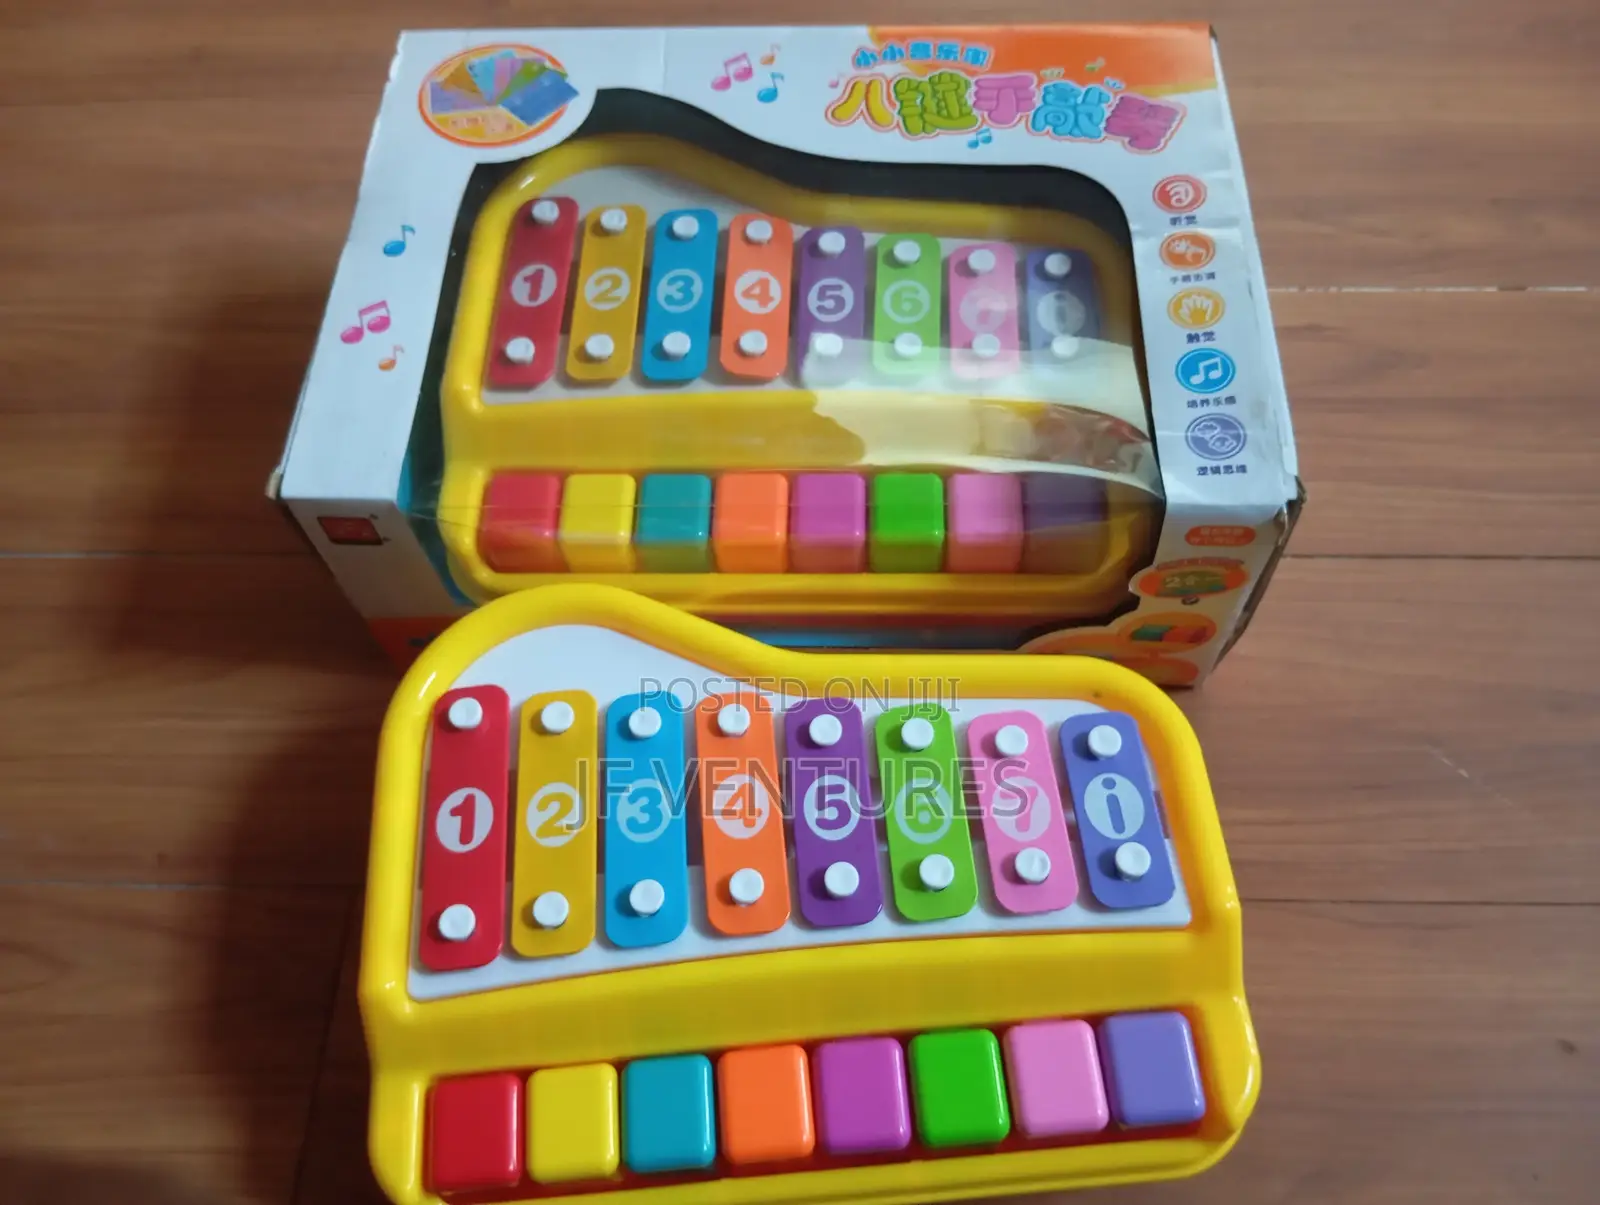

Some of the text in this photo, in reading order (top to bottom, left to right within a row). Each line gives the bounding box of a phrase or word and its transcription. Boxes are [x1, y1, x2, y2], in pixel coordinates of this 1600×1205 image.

[523, 269, 545, 301] 1
[591, 274, 622, 301] 2
[664, 274, 695, 306] 3
[742, 277, 775, 308] 4
[815, 284, 846, 316] 5
[890, 284, 924, 319] 6
[448, 792, 477, 846] 1
[535, 791, 575, 839] 2
[624, 785, 664, 835] 3
[720, 781, 762, 829] 4
[815, 783, 852, 832] 5
[903, 785, 946, 834] 6
